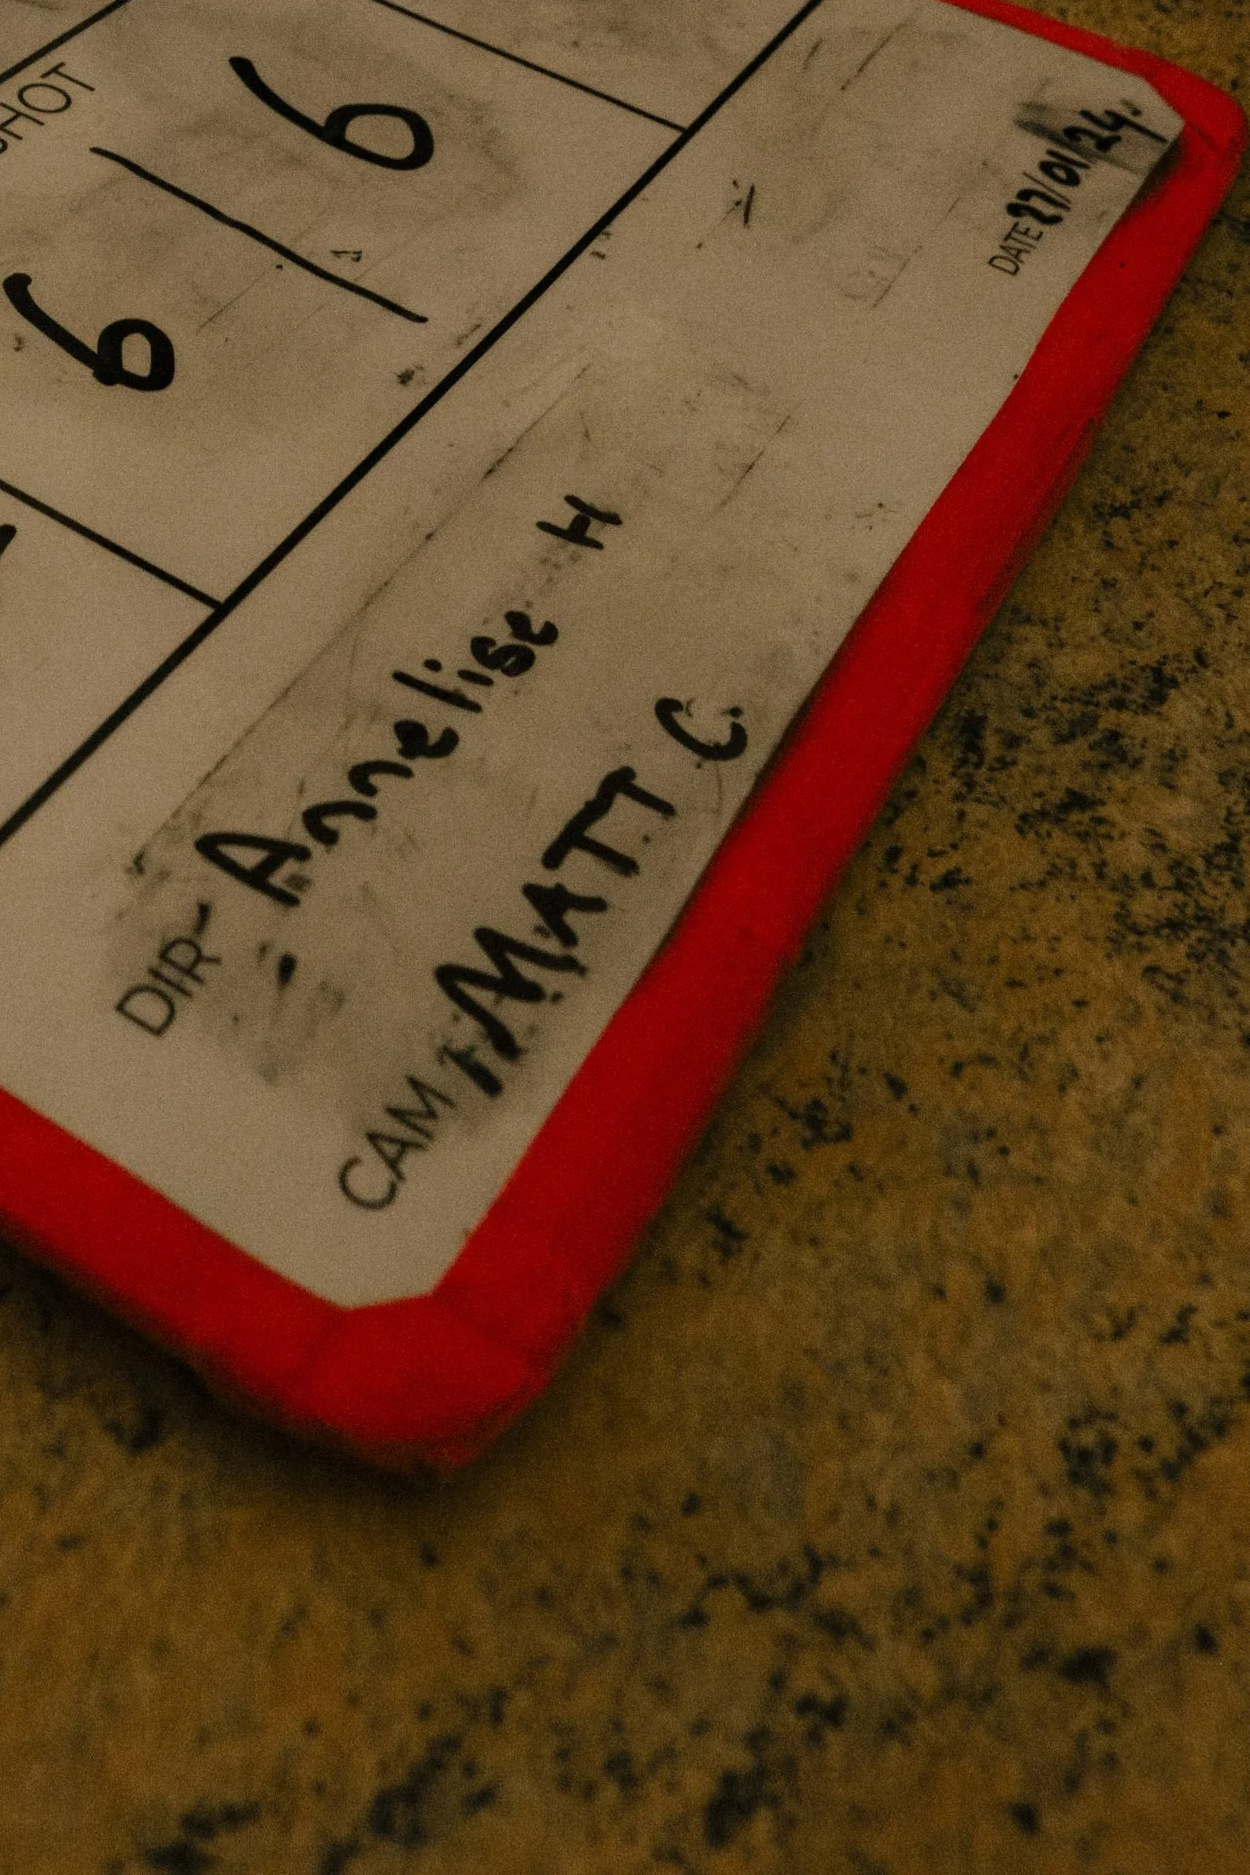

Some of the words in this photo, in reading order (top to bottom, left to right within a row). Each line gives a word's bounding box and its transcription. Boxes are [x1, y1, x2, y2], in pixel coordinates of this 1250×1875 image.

[230, 56, 435, 171] 6
[987, 222, 1043, 276] DATE
[2, 272, 176, 392] 6
[194, 609, 560, 907] Annelise
[536, 494, 623, 550] H
[338, 1074, 457, 1212] CAM
[434, 765, 677, 1061] MATT
